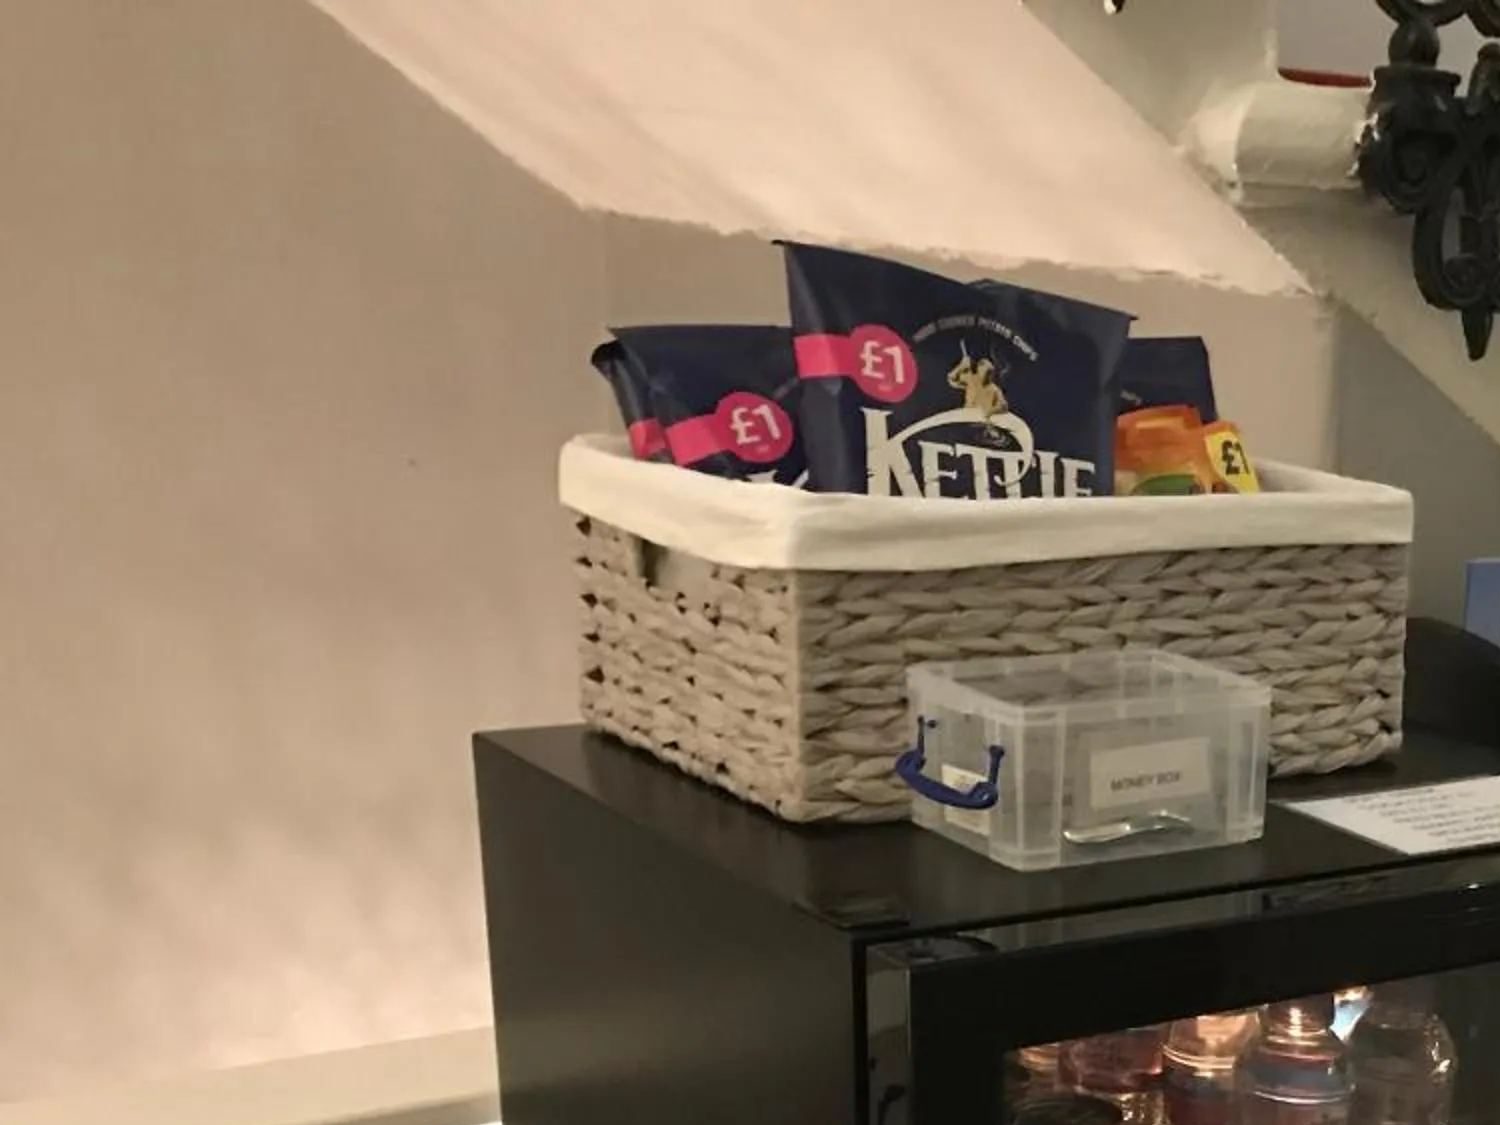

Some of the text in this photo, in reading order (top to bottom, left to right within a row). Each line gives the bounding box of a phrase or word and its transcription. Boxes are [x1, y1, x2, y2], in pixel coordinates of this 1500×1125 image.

[860, 340, 905, 384] £1
[729, 403, 782, 444] £1
[1221, 440, 1250, 475] £1
